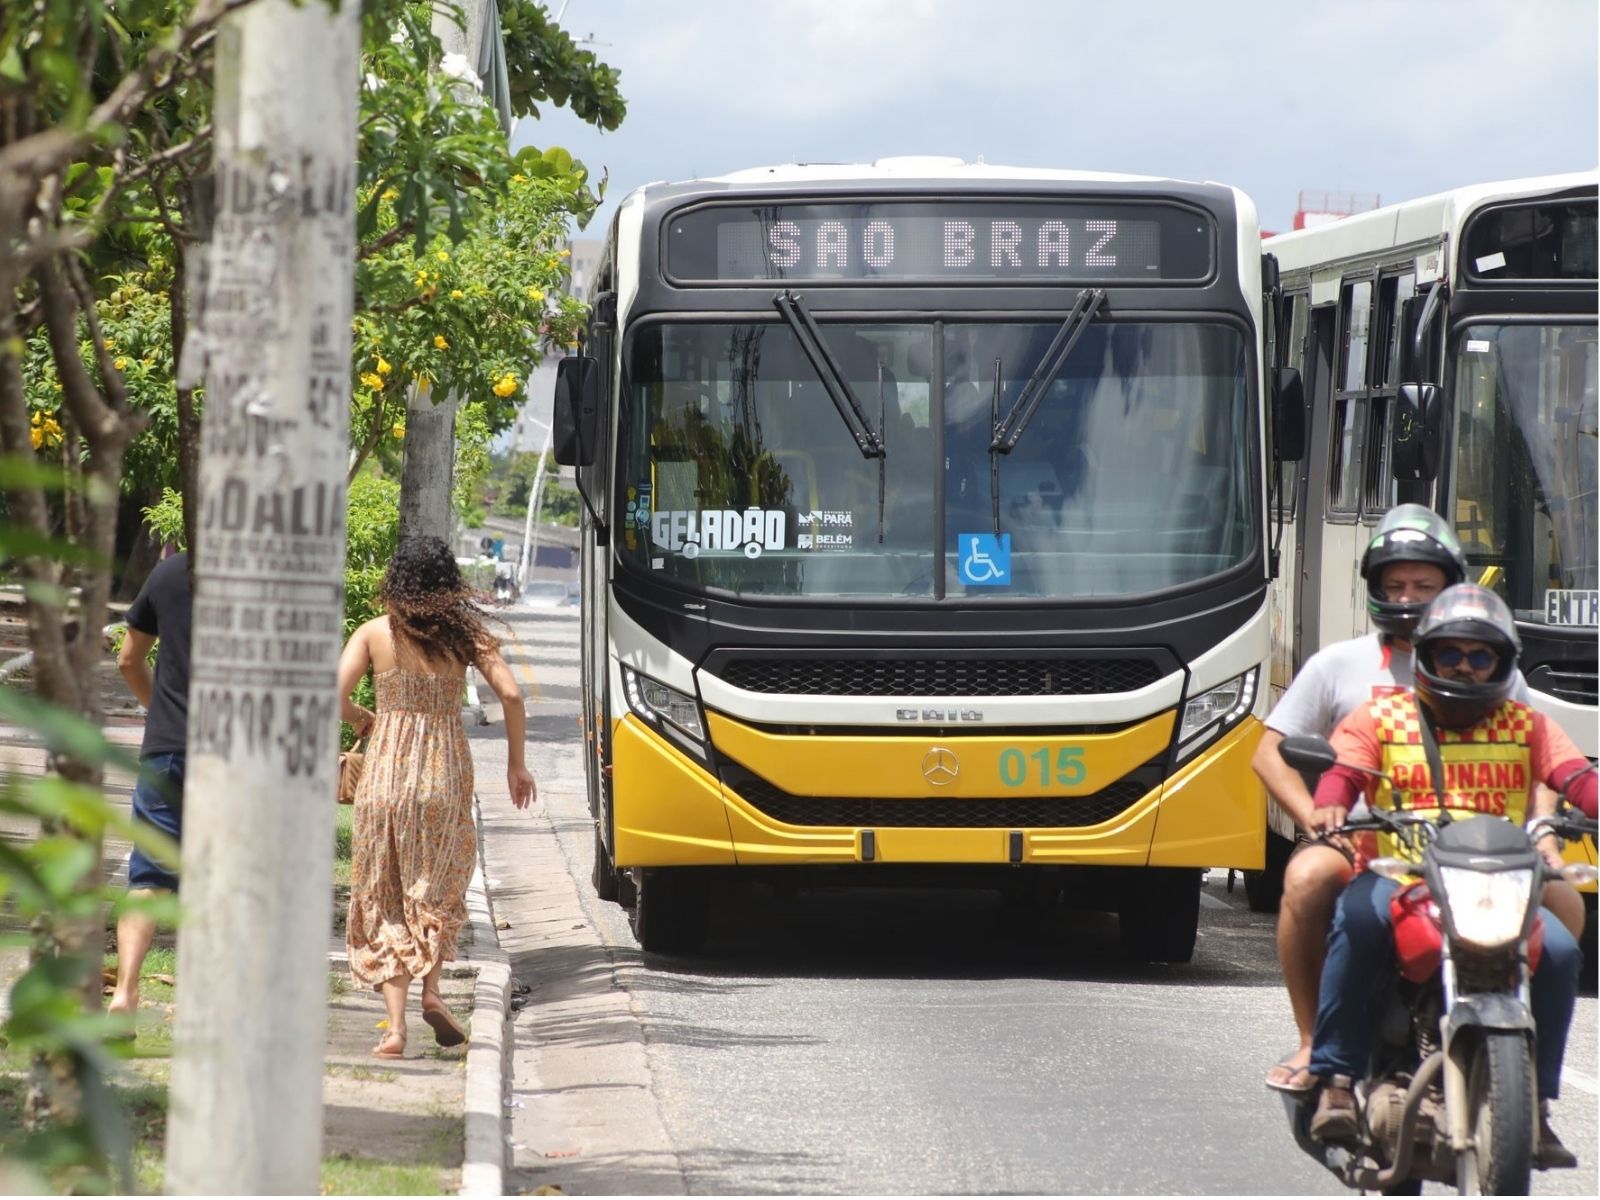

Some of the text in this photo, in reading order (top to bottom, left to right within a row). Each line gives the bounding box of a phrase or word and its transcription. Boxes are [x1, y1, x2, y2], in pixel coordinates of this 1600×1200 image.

[769, 220, 1117, 268] SAO BRAZ
[816, 533, 852, 544] BELÉM
[896, 709, 984, 721] CAIO
[998, 747, 1087, 788] 015
[1392, 762, 1525, 790] CAINANA
